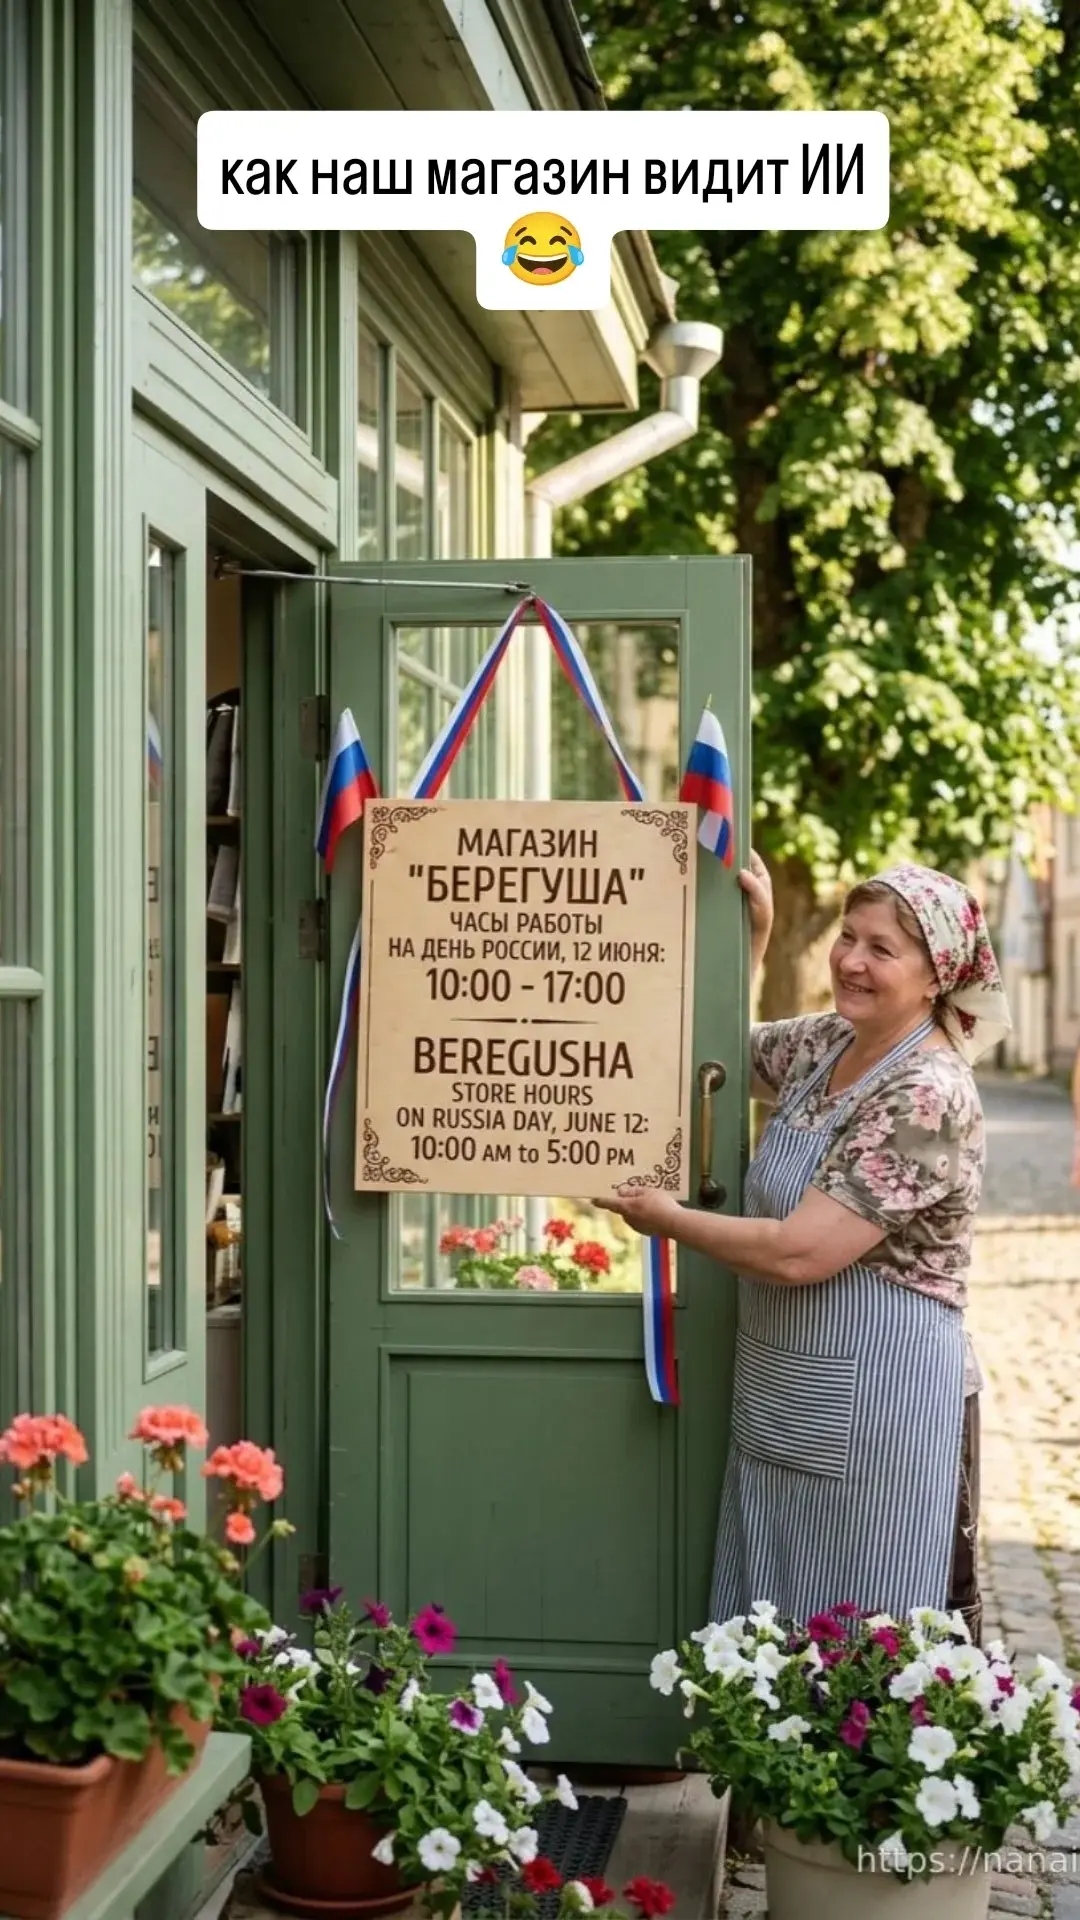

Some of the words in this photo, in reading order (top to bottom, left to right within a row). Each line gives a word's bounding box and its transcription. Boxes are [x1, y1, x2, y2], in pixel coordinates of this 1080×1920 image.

[457, 827, 598, 859] МАГАЗИН
[408, 863, 645, 906] "БЕРЕГУША"
[449, 911, 509, 933] ЧАСЫ
[516, 912, 603, 935] РАБОТЫ
[388, 937, 415, 958] НА
[420, 938, 476, 963] ДЕНЬ
[481, 938, 566, 964] РОССИИ,
[572, 941, 592, 962] 12
[598, 941, 666, 963] ИЮНЯ:
[425, 967, 511, 1003] 10:00
[543, 970, 626, 1006] 17:00
[414, 1036, 634, 1080] BEREGUSHA
[451, 1081, 517, 1104] STORE
[523, 1083, 594, 1107] HOURS
[396, 1106, 425, 1128] ON
[432, 1107, 506, 1131] RUSSIA
[513, 1109, 557, 1136] DAY,
[563, 1111, 617, 1134] JUNE
[623, 1113, 649, 1134] 12:
[411, 1135, 477, 1162] 10:00
[481, 1143, 512, 1163] AM
[517, 1144, 540, 1164] to
[547, 1138, 601, 1166] 5:00
[606, 1147, 635, 1167] PM
